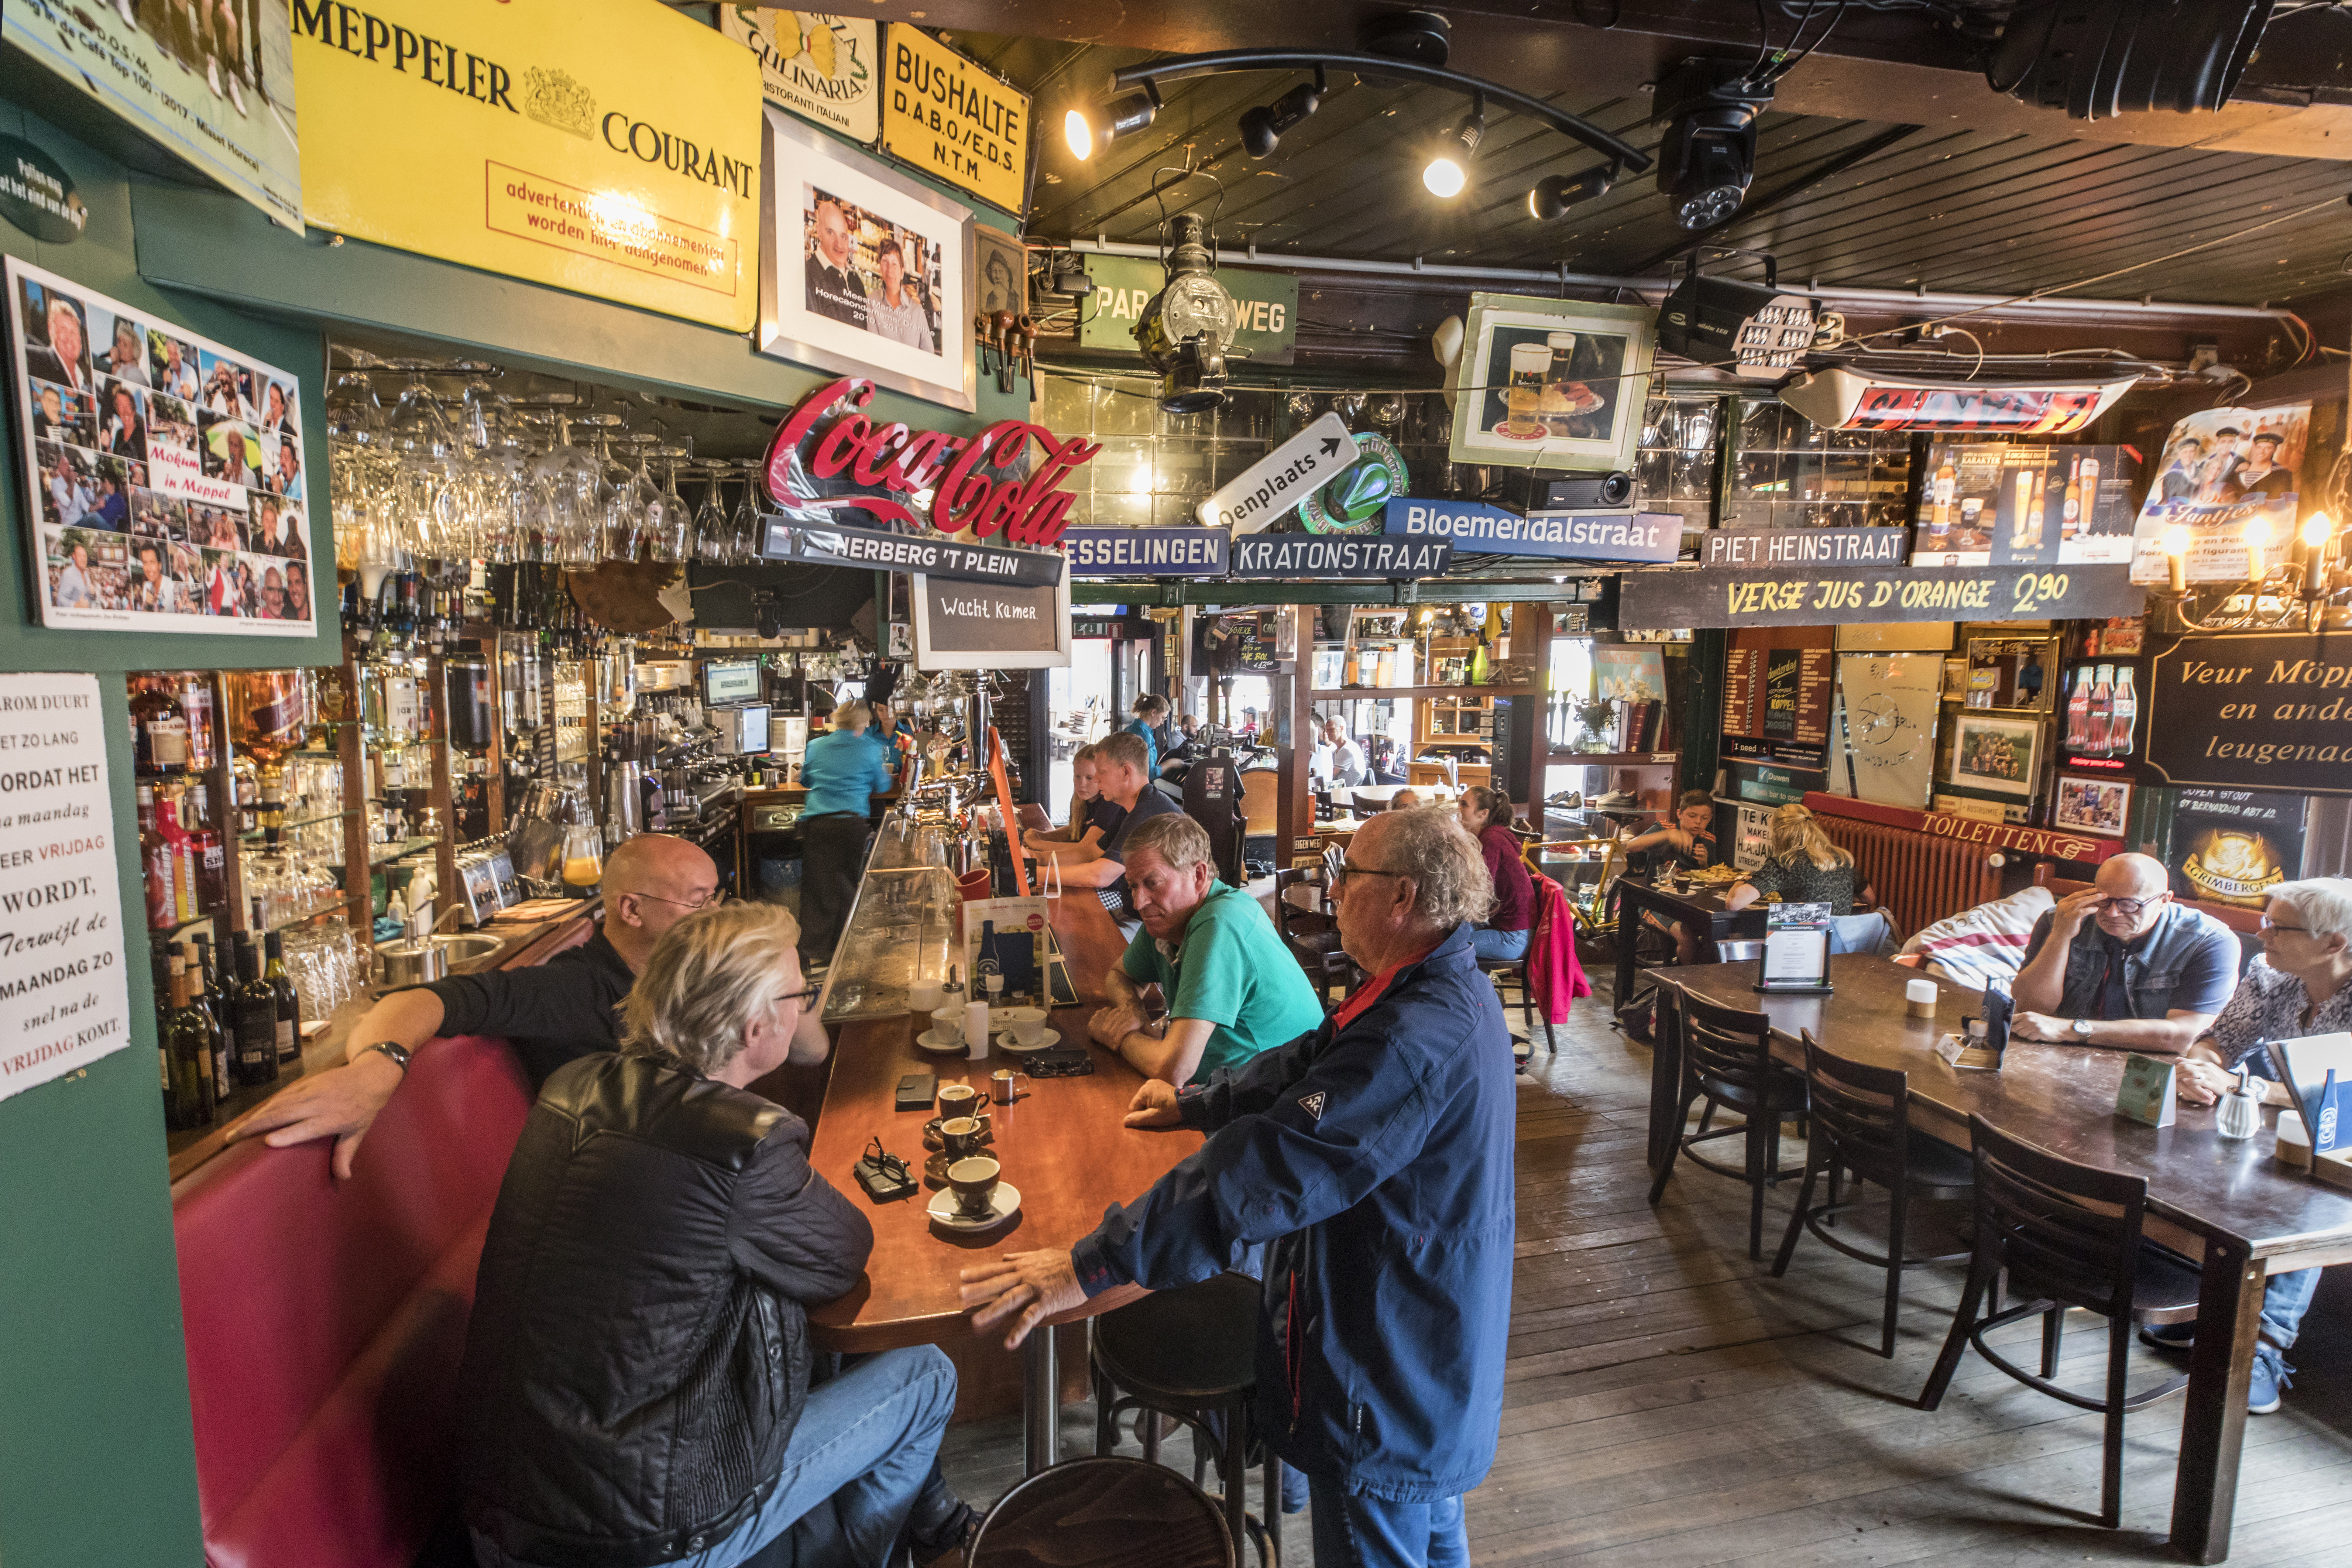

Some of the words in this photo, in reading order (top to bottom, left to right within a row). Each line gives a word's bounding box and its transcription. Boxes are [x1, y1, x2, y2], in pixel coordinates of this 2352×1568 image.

[291, 0, 519, 114] MEPPELER
[748, 30, 863, 102] CULINARIA
[762, 82, 814, 111] RISTORANTI
[816, 104, 850, 128] ITALIANI
[896, 42, 1019, 146] BUSHALTE
[109, 52, 130, 79] Top
[133, 71, 152, 94] 100
[161, 91, 188, 120] (2017
[196, 117, 226, 148] Misset
[227, 139, 259, 173] Horeca)
[602, 111, 753, 199] COURANT
[934, 141, 982, 183] N.T.M.
[527, 212, 585, 241] worden
[591, 225, 618, 251] hier
[625, 241, 708, 277] aangenomen
[815, 287, 902, 326] Horecaondernemer
[903, 320, 936, 337] Drenthe
[843, 288, 871, 305] Meest
[873, 298, 913, 320] Markante
[853, 311, 876, 325] 2010
[883, 320, 904, 335] 2011
[150, 444, 201, 473] Mokum
[761, 376, 1103, 548] Coca-Cola
[1961, 457, 2001, 465] KARAKTER
[164, 473, 178, 489] in
[181, 477, 231, 501] Meppel
[1219, 452, 1316, 526] oenplaats
[1406, 507, 1660, 548] Bloemendalstraat
[833, 536, 935, 566] HERBERG
[942, 549, 961, 569] 'T
[965, 553, 1019, 576] PLEIN
[1063, 538, 1218, 565] ESSELINGEN
[1239, 543, 1447, 570] KRATONSTRAAT
[1710, 535, 1761, 563] PIET
[1769, 533, 1903, 562] HEINSTRAAT
[941, 597, 989, 619] Wacht
[1728, 581, 1807, 615] VERSE
[1812, 581, 1864, 611] JUS
[1868, 579, 1996, 609] D'ORANGE
[1768, 659, 1797, 680] donderdag
[2182, 661, 2252, 684] Veur
[0, 695, 37, 711] ROM
[41, 694, 90, 711] DUURT
[2220, 703, 2256, 720] en
[21, 733, 40, 748] ZO
[43, 731, 79, 746] LANG
[68, 764, 99, 785] HET
[1768, 772, 1790, 782] Duwen
[2191, 800, 2241, 815] BERNARDUS
[2242, 806, 2265, 818] ABT
[2219, 791, 2254, 801] STOUT
[18, 803, 90, 826] maandag
[1743, 809, 1756, 823] TE
[1966, 804, 1999, 817] RUSTRUIMTE
[38, 834, 105, 860] VRIJDAG
[1295, 839, 1309, 850] EIGEN
[1309, 838, 1320, 848] WEG
[1921, 814, 2052, 854] TOILETTEN
[2190, 867, 2275, 893] GRIMBERGEN
[1, 875, 97, 915] WORDT,
[86, 911, 107, 932] de
[1944, 912, 1987, 934] post
[0, 958, 89, 1002] MAANDAG
[92, 951, 113, 972] ZO
[23, 1005, 56, 1033] snel
[59, 1001, 79, 1019] na
[82, 992, 100, 1011] de
[1, 1035, 74, 1077] VRIJDAG
[76, 1017, 121, 1049] KOMT.
